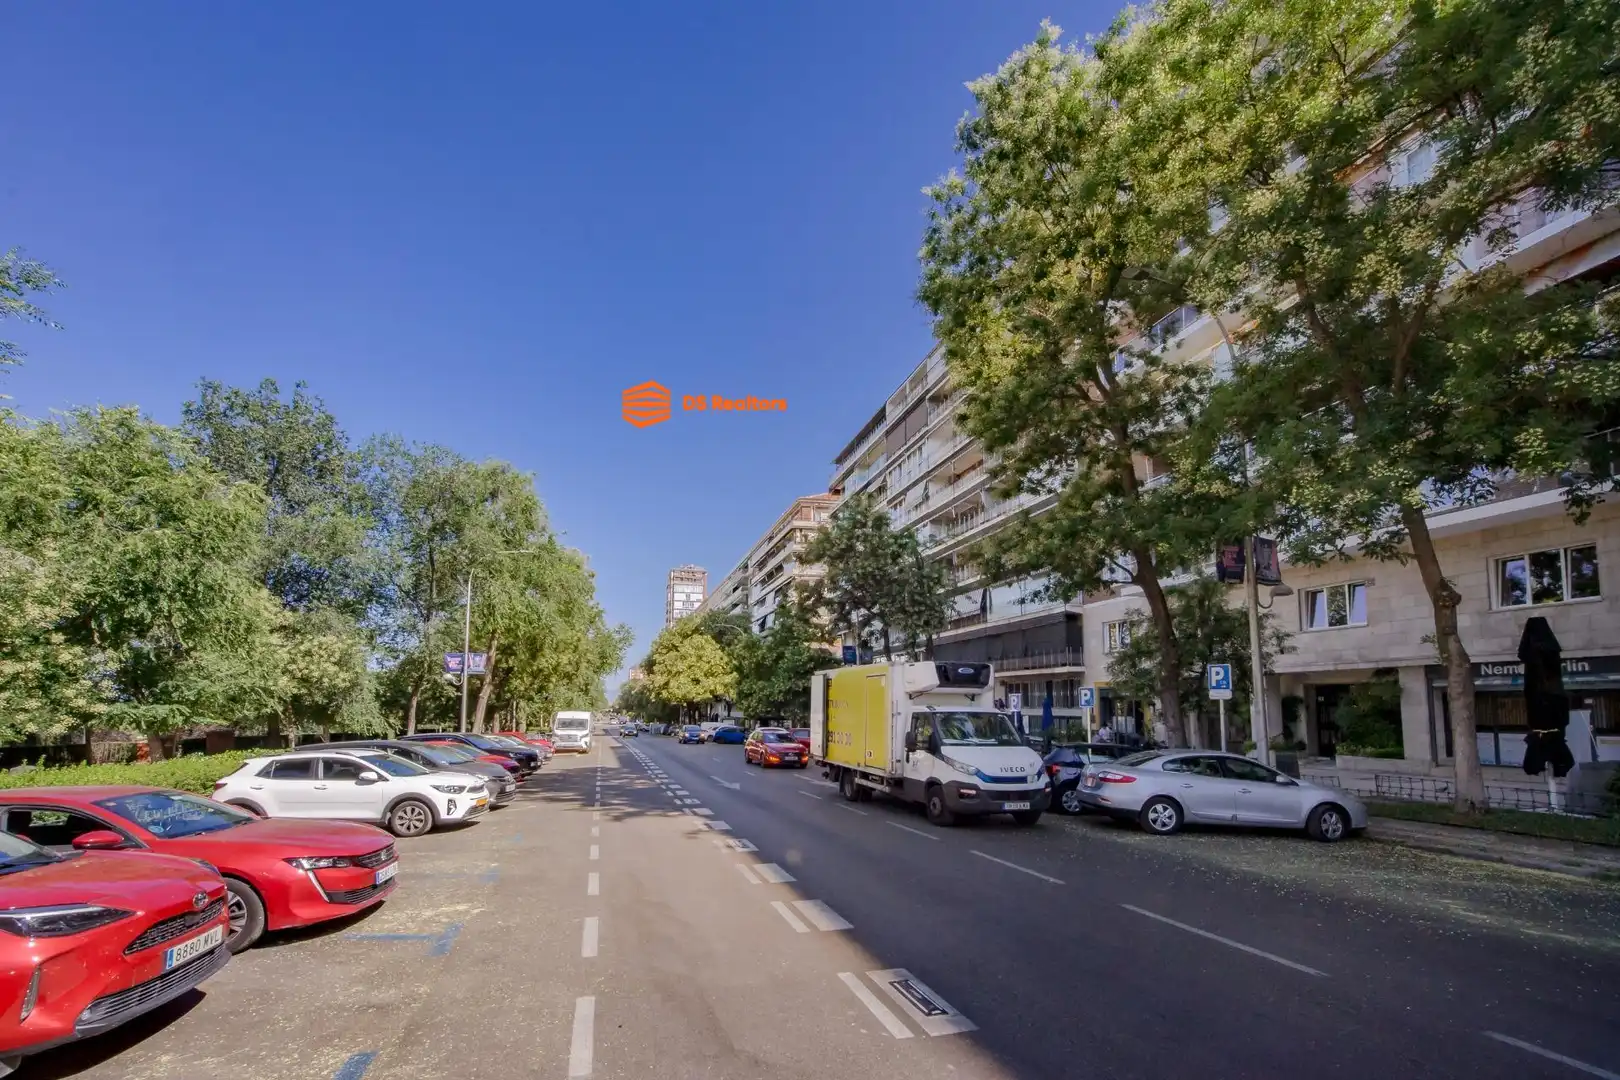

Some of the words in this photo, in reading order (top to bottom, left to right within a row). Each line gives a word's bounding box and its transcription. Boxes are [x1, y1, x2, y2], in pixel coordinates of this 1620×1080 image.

[1211, 667, 1224, 687] P
[1081, 689, 1091, 705] P
[175, 939, 201, 962] 8880
